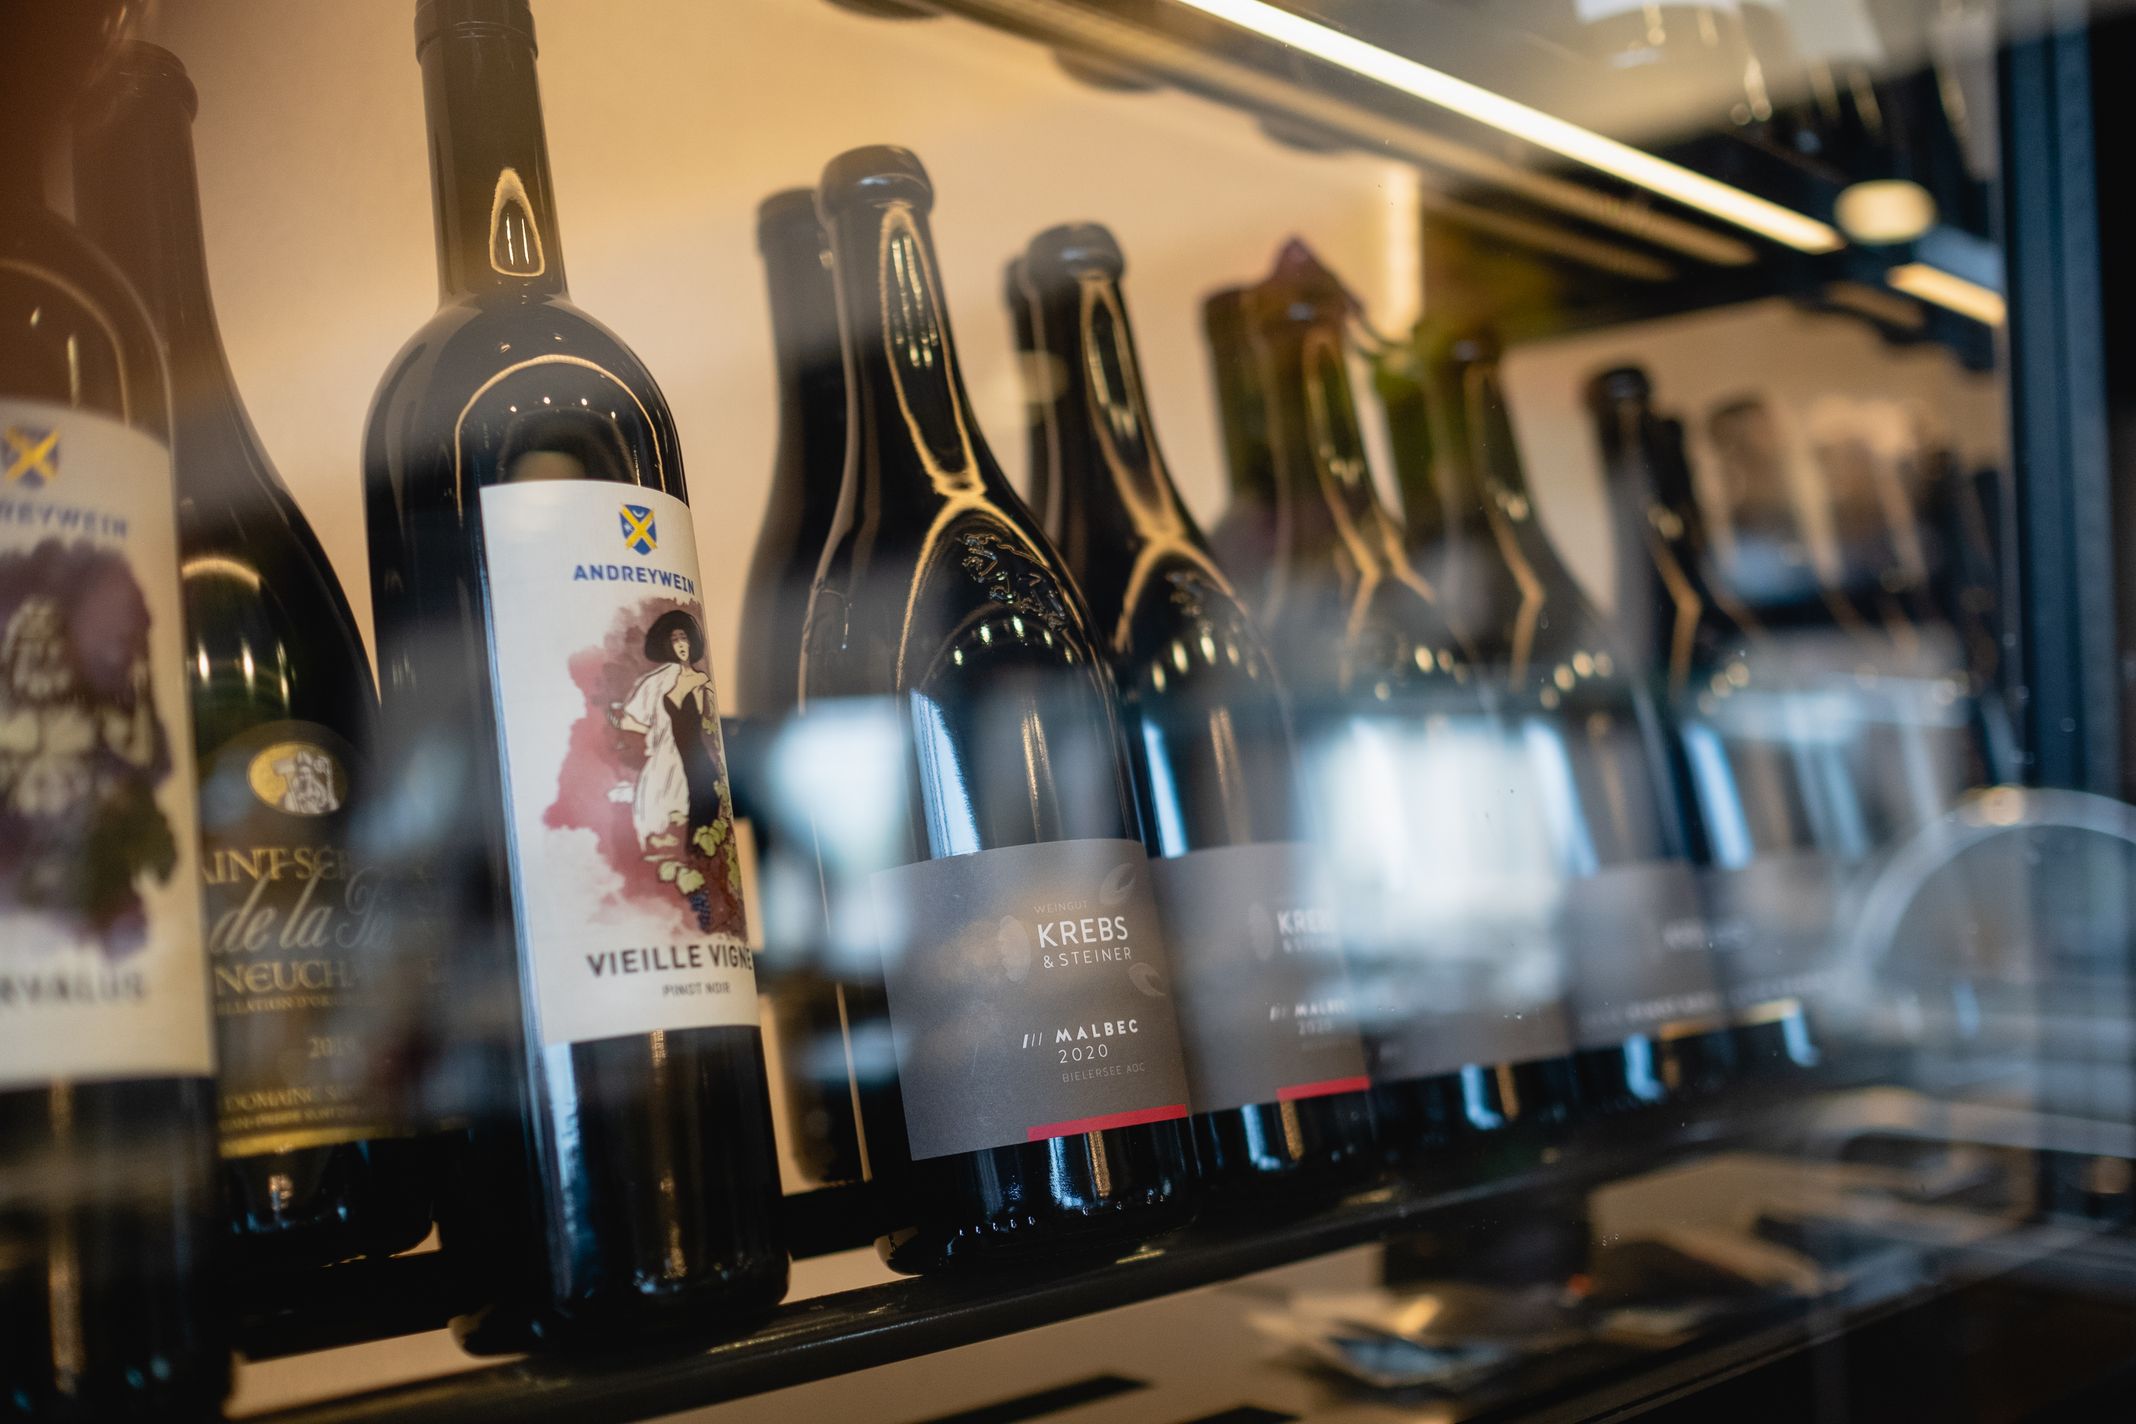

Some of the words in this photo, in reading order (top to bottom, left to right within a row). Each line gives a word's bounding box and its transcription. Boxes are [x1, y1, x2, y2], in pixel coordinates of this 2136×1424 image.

[574, 564, 696, 596] ANDREYWEIN
[1033, 901, 1087, 915] WEINGUT
[1037, 916, 1128, 949] KREBS
[586, 945, 703, 977] VIEILLE
[1043, 955, 1054, 969] &
[1058, 946, 1132, 967] STEINER
[662, 983, 702, 997] PINOT
[1055, 1019, 1139, 1043] MALBEC
[1058, 1043, 1108, 1064] 2020
[1062, 1065, 1122, 1083] BIELERSEE
[1126, 1061, 1145, 1074] AOC
